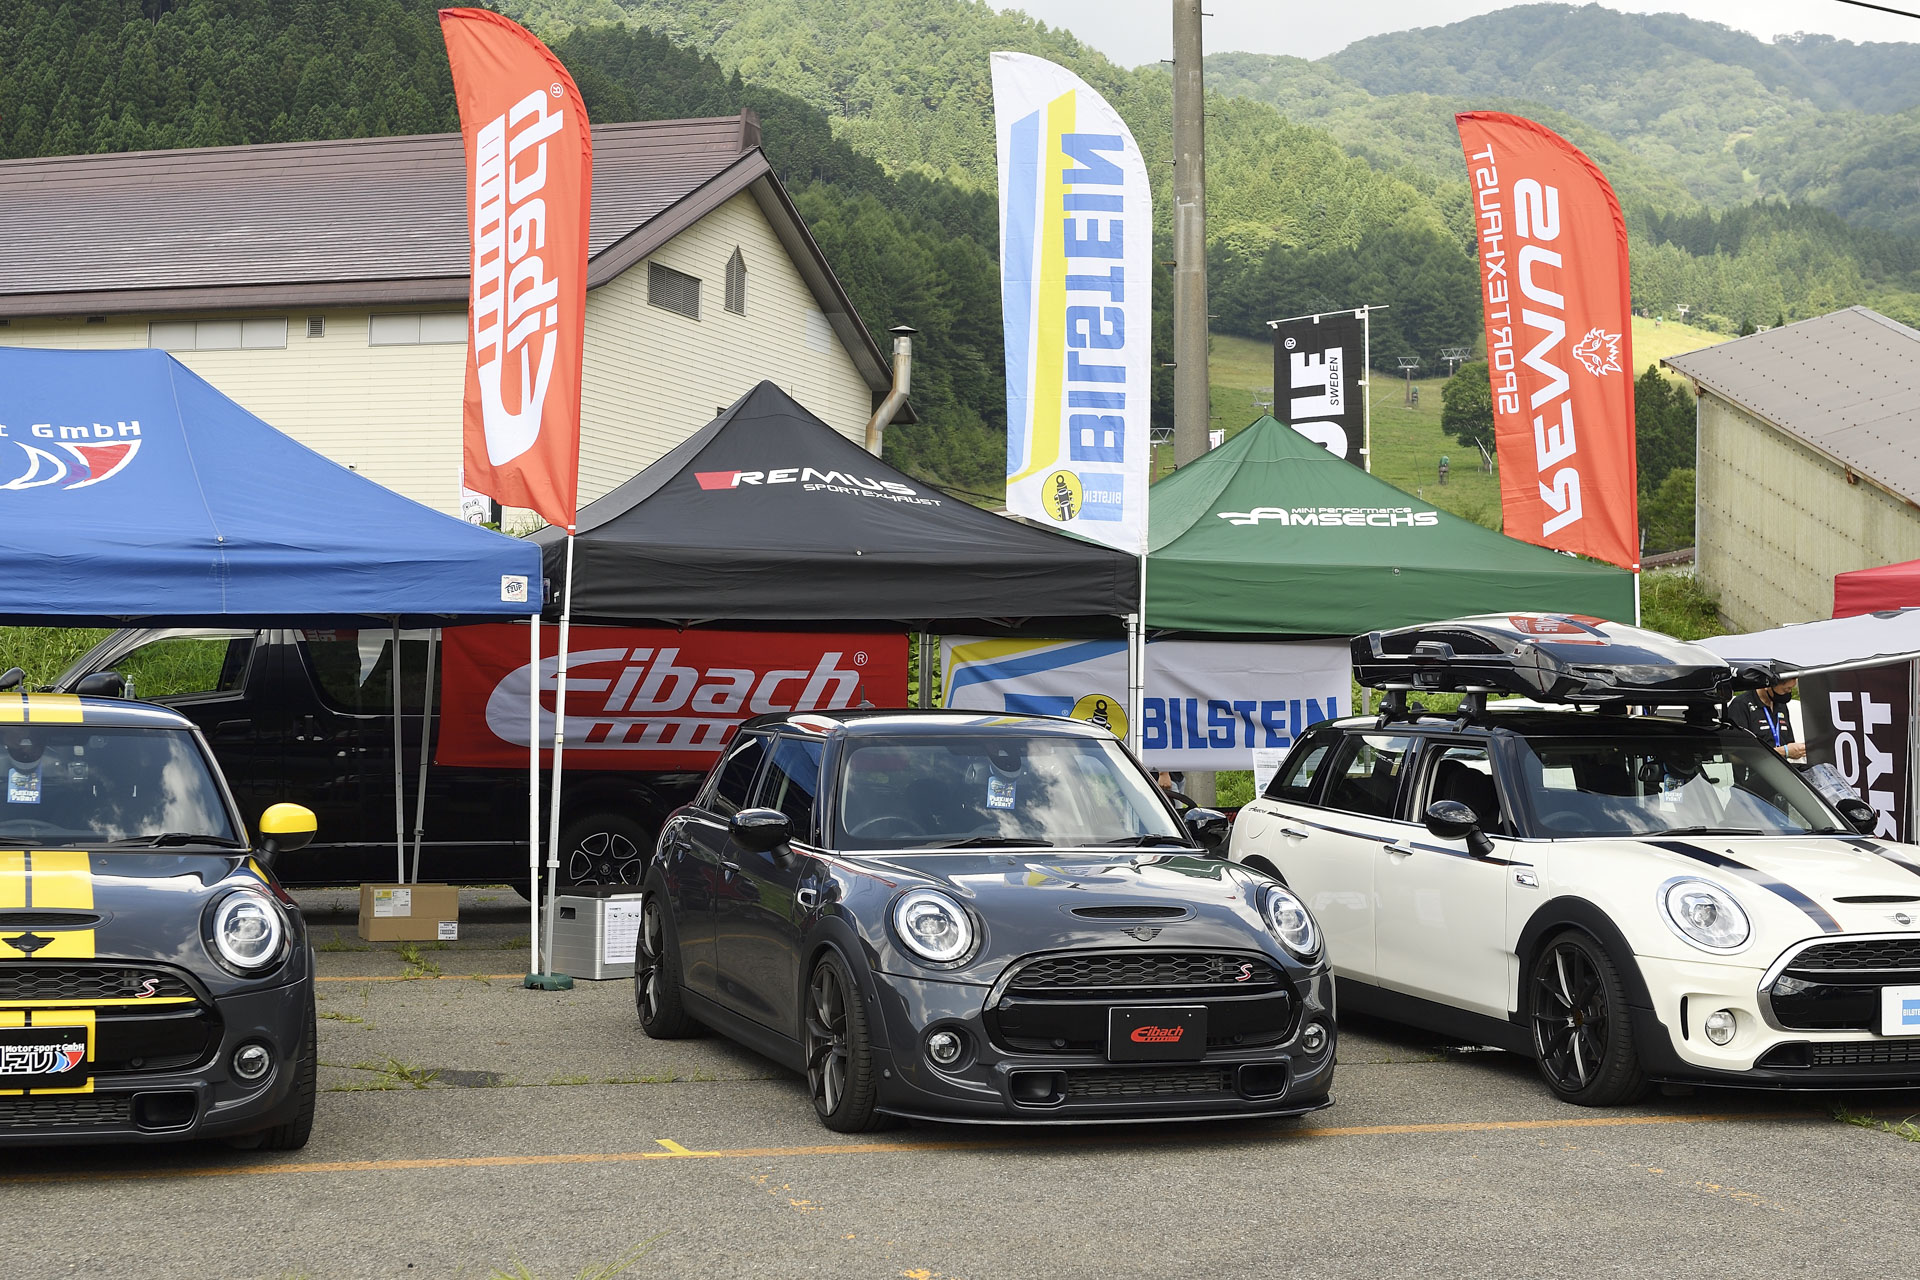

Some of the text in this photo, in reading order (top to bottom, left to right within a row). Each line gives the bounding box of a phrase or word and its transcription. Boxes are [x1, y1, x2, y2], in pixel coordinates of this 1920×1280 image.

[1329, 356, 1340, 406] SWEDEN
[31, 420, 142, 439] GmbH
[730, 467, 918, 496] REMUS
[803, 483, 943, 507] SPORTEXHAUST
[485, 647, 865, 751] Eibach
[1143, 696, 1338, 750] BILSTEIN
[1235, 964, 1253, 982] S
[135, 979, 159, 998] S
[1130, 1026, 1184, 1043] Eibach
